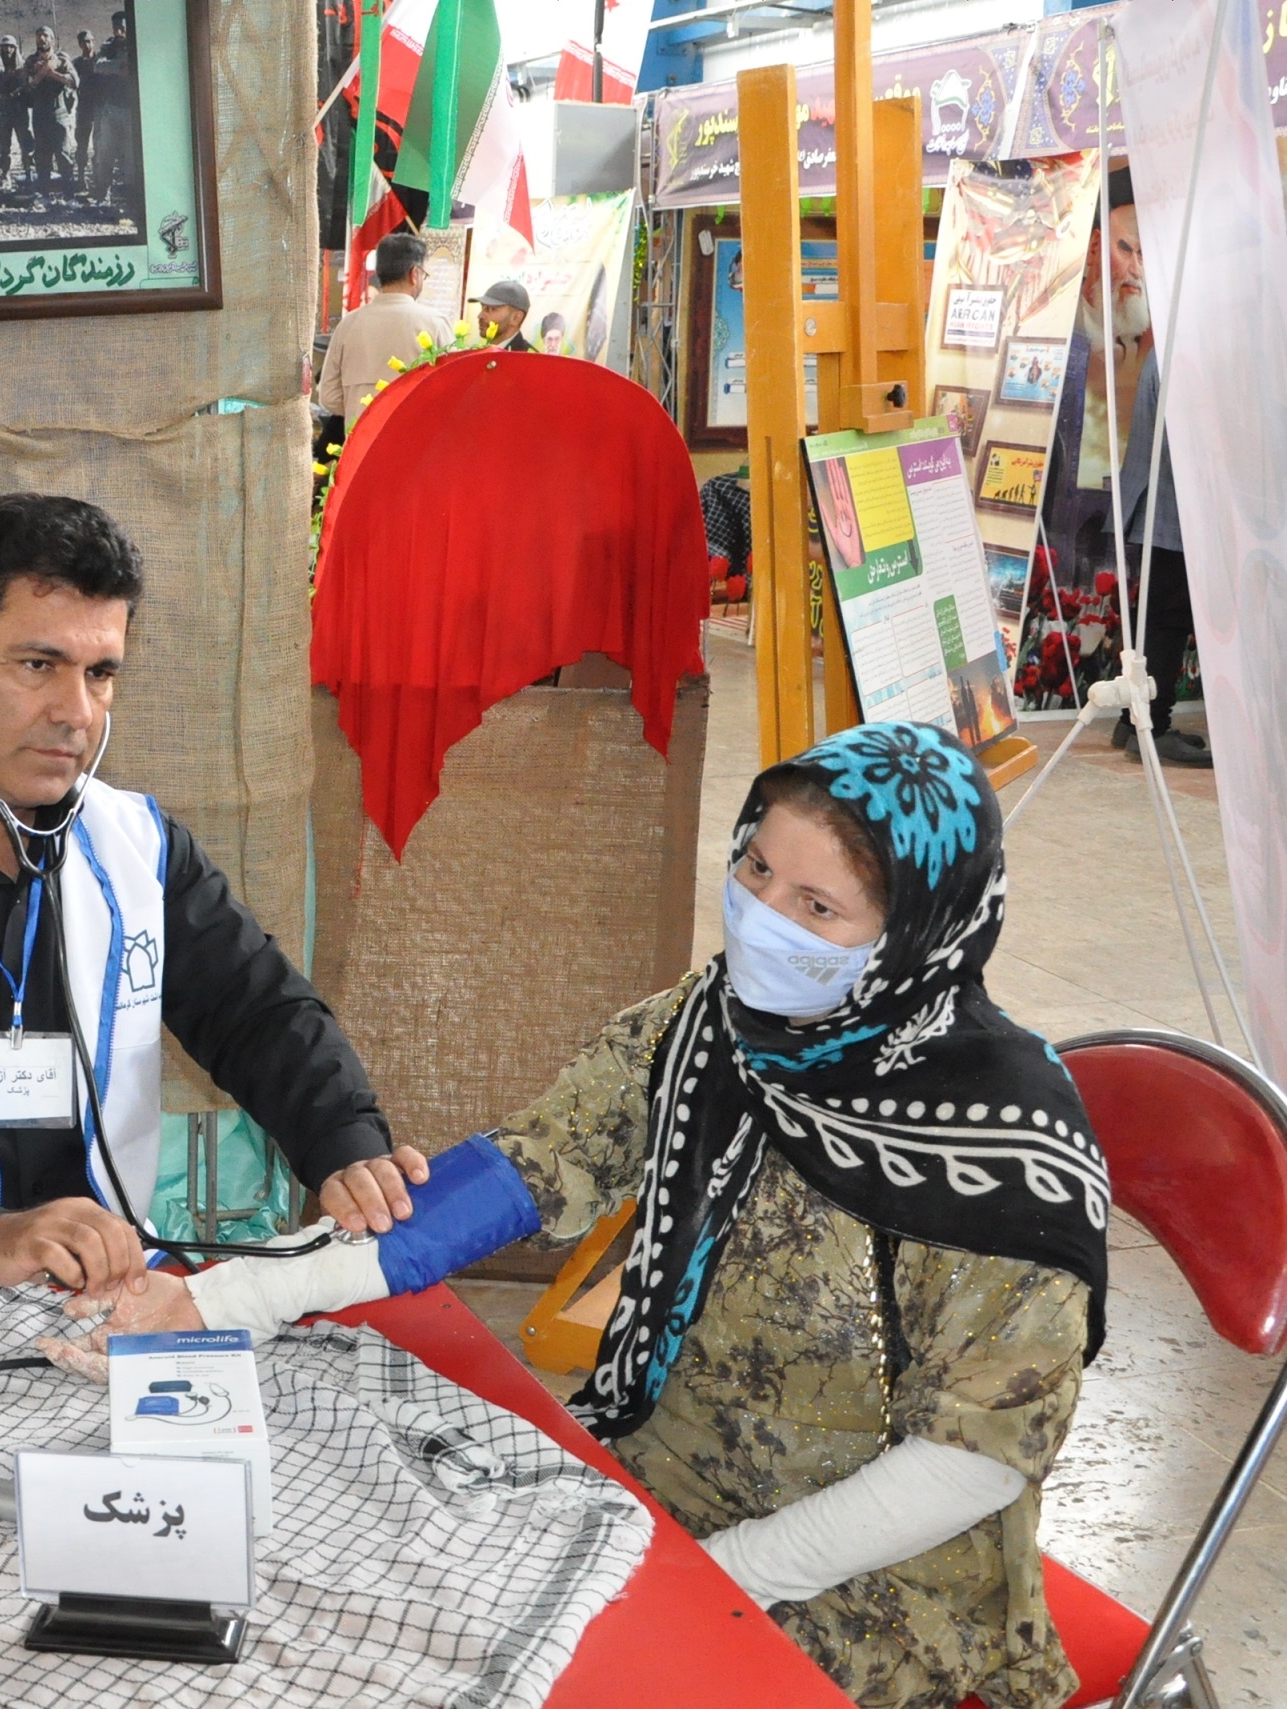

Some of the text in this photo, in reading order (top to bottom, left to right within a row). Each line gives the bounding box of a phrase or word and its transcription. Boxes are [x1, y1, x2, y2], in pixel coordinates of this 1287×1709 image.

[42, 252, 136, 288] رزمندگان
[11, 1069, 32, 1083] دکتر
[176, 1334, 240, 1344] microlife
[82, 1490, 188, 1540] پزشک
